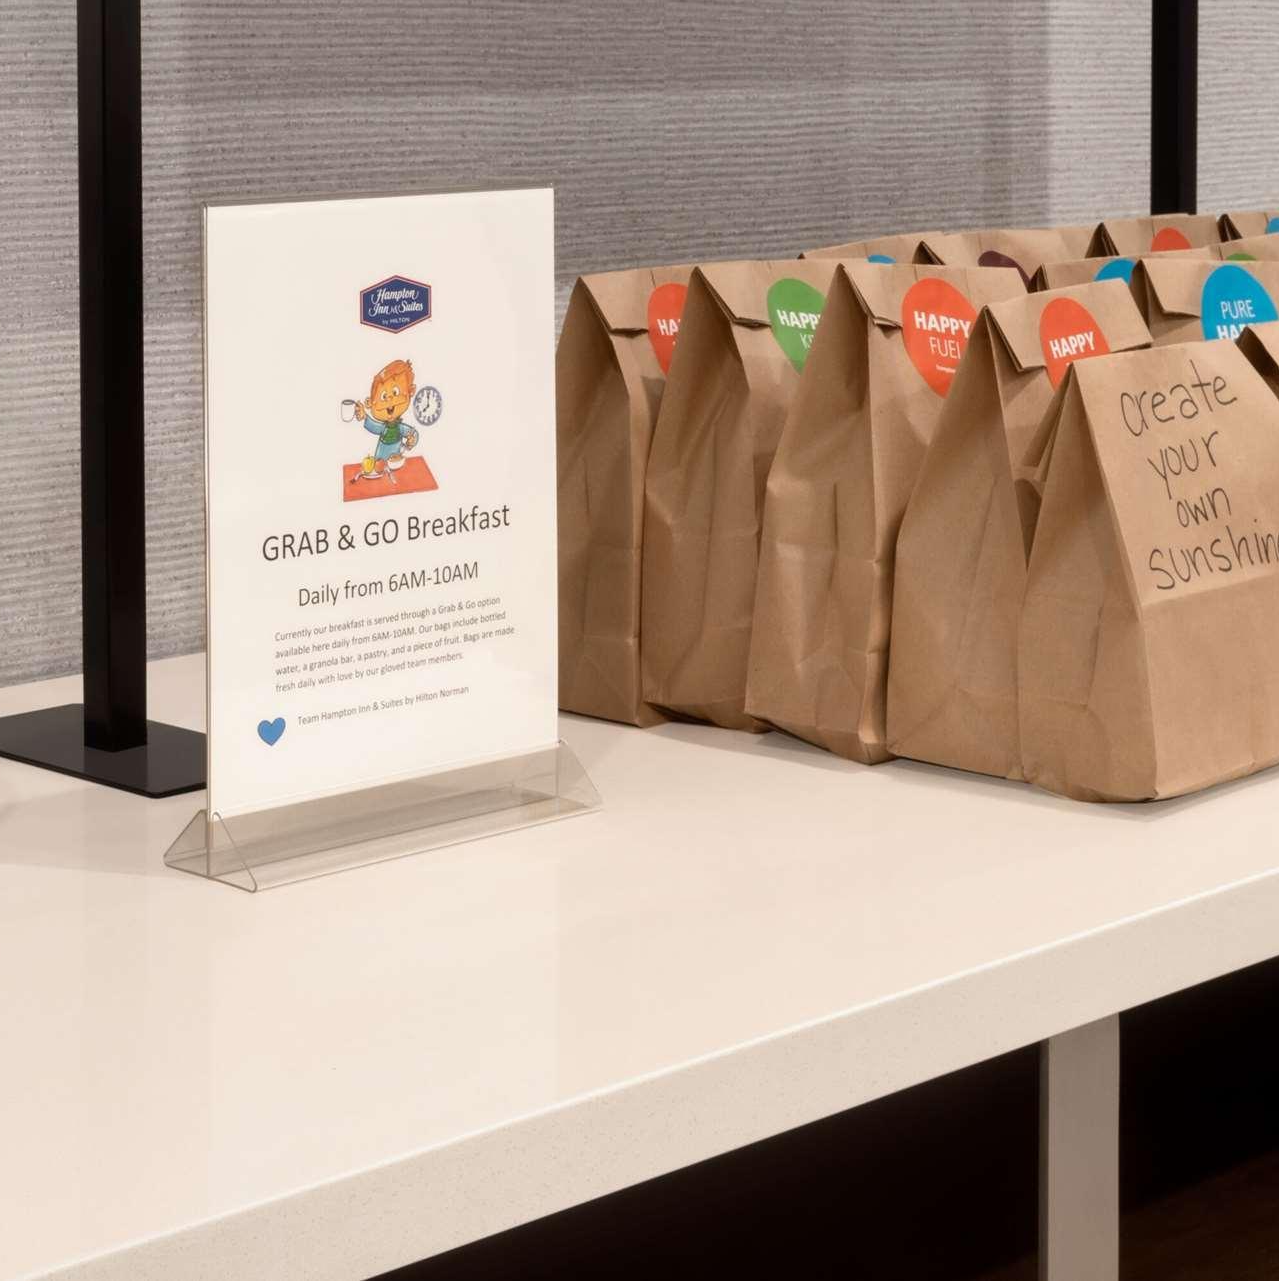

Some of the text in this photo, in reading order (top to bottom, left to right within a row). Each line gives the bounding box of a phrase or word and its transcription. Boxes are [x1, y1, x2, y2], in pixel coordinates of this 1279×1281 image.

[368, 303, 390, 317] Inn
[398, 299, 424, 313] Suites
[370, 287, 420, 305] Hampton
[1220, 299, 1257, 320] PURE
[776, 309, 821, 330] HAPP
[913, 310, 972, 339] HAPPY
[1049, 331, 1095, 359] HAPPY
[1147, 430, 1219, 500] your
[1175, 487, 1232, 529] own
[262, 504, 511, 561] GRAB & GO Breakfast
[298, 561, 480, 607] Daily from 6AM-10AM
[275, 628, 312, 643] Currently
[313, 626, 328, 635] our
[329, 618, 365, 633] breakfast
[366, 618, 373, 626] is
[374, 613, 400, 626] served
[401, 608, 431, 620] through
[438, 603, 456, 614] Grab
[457, 601, 464, 611] &
[465, 600, 476, 609] Go
[477, 597, 501, 609] option
[275, 645, 311, 659] available
[312, 642, 330, 652] here
[331, 638, 351, 650] daily
[352, 635, 371, 645] from
[418, 624, 433, 634] Our
[434, 621, 451, 632] bags
[452, 616, 479, 628] include
[480, 611, 506, 623] bottled
[309, 657, 339, 672] granola
[391, 644, 405, 655] and
[413, 640, 433, 653] piece
[434, 637, 443, 648] of
[463, 632, 480, 644] Bags
[481, 630, 494, 639] are
[494, 626, 516, 637] made
[275, 681, 296, 694] fresh
[297, 676, 317, 690] daily
[317, 673, 336, 685] with
[337, 670, 353, 681] love
[354, 667, 365, 680] by
[365, 666, 379, 676] our
[380, 660, 406, 677] gloved
[407, 657, 427, 668] team
[297, 685, 470, 726] Team Hampton Inn & Suites by Hilton Norman
